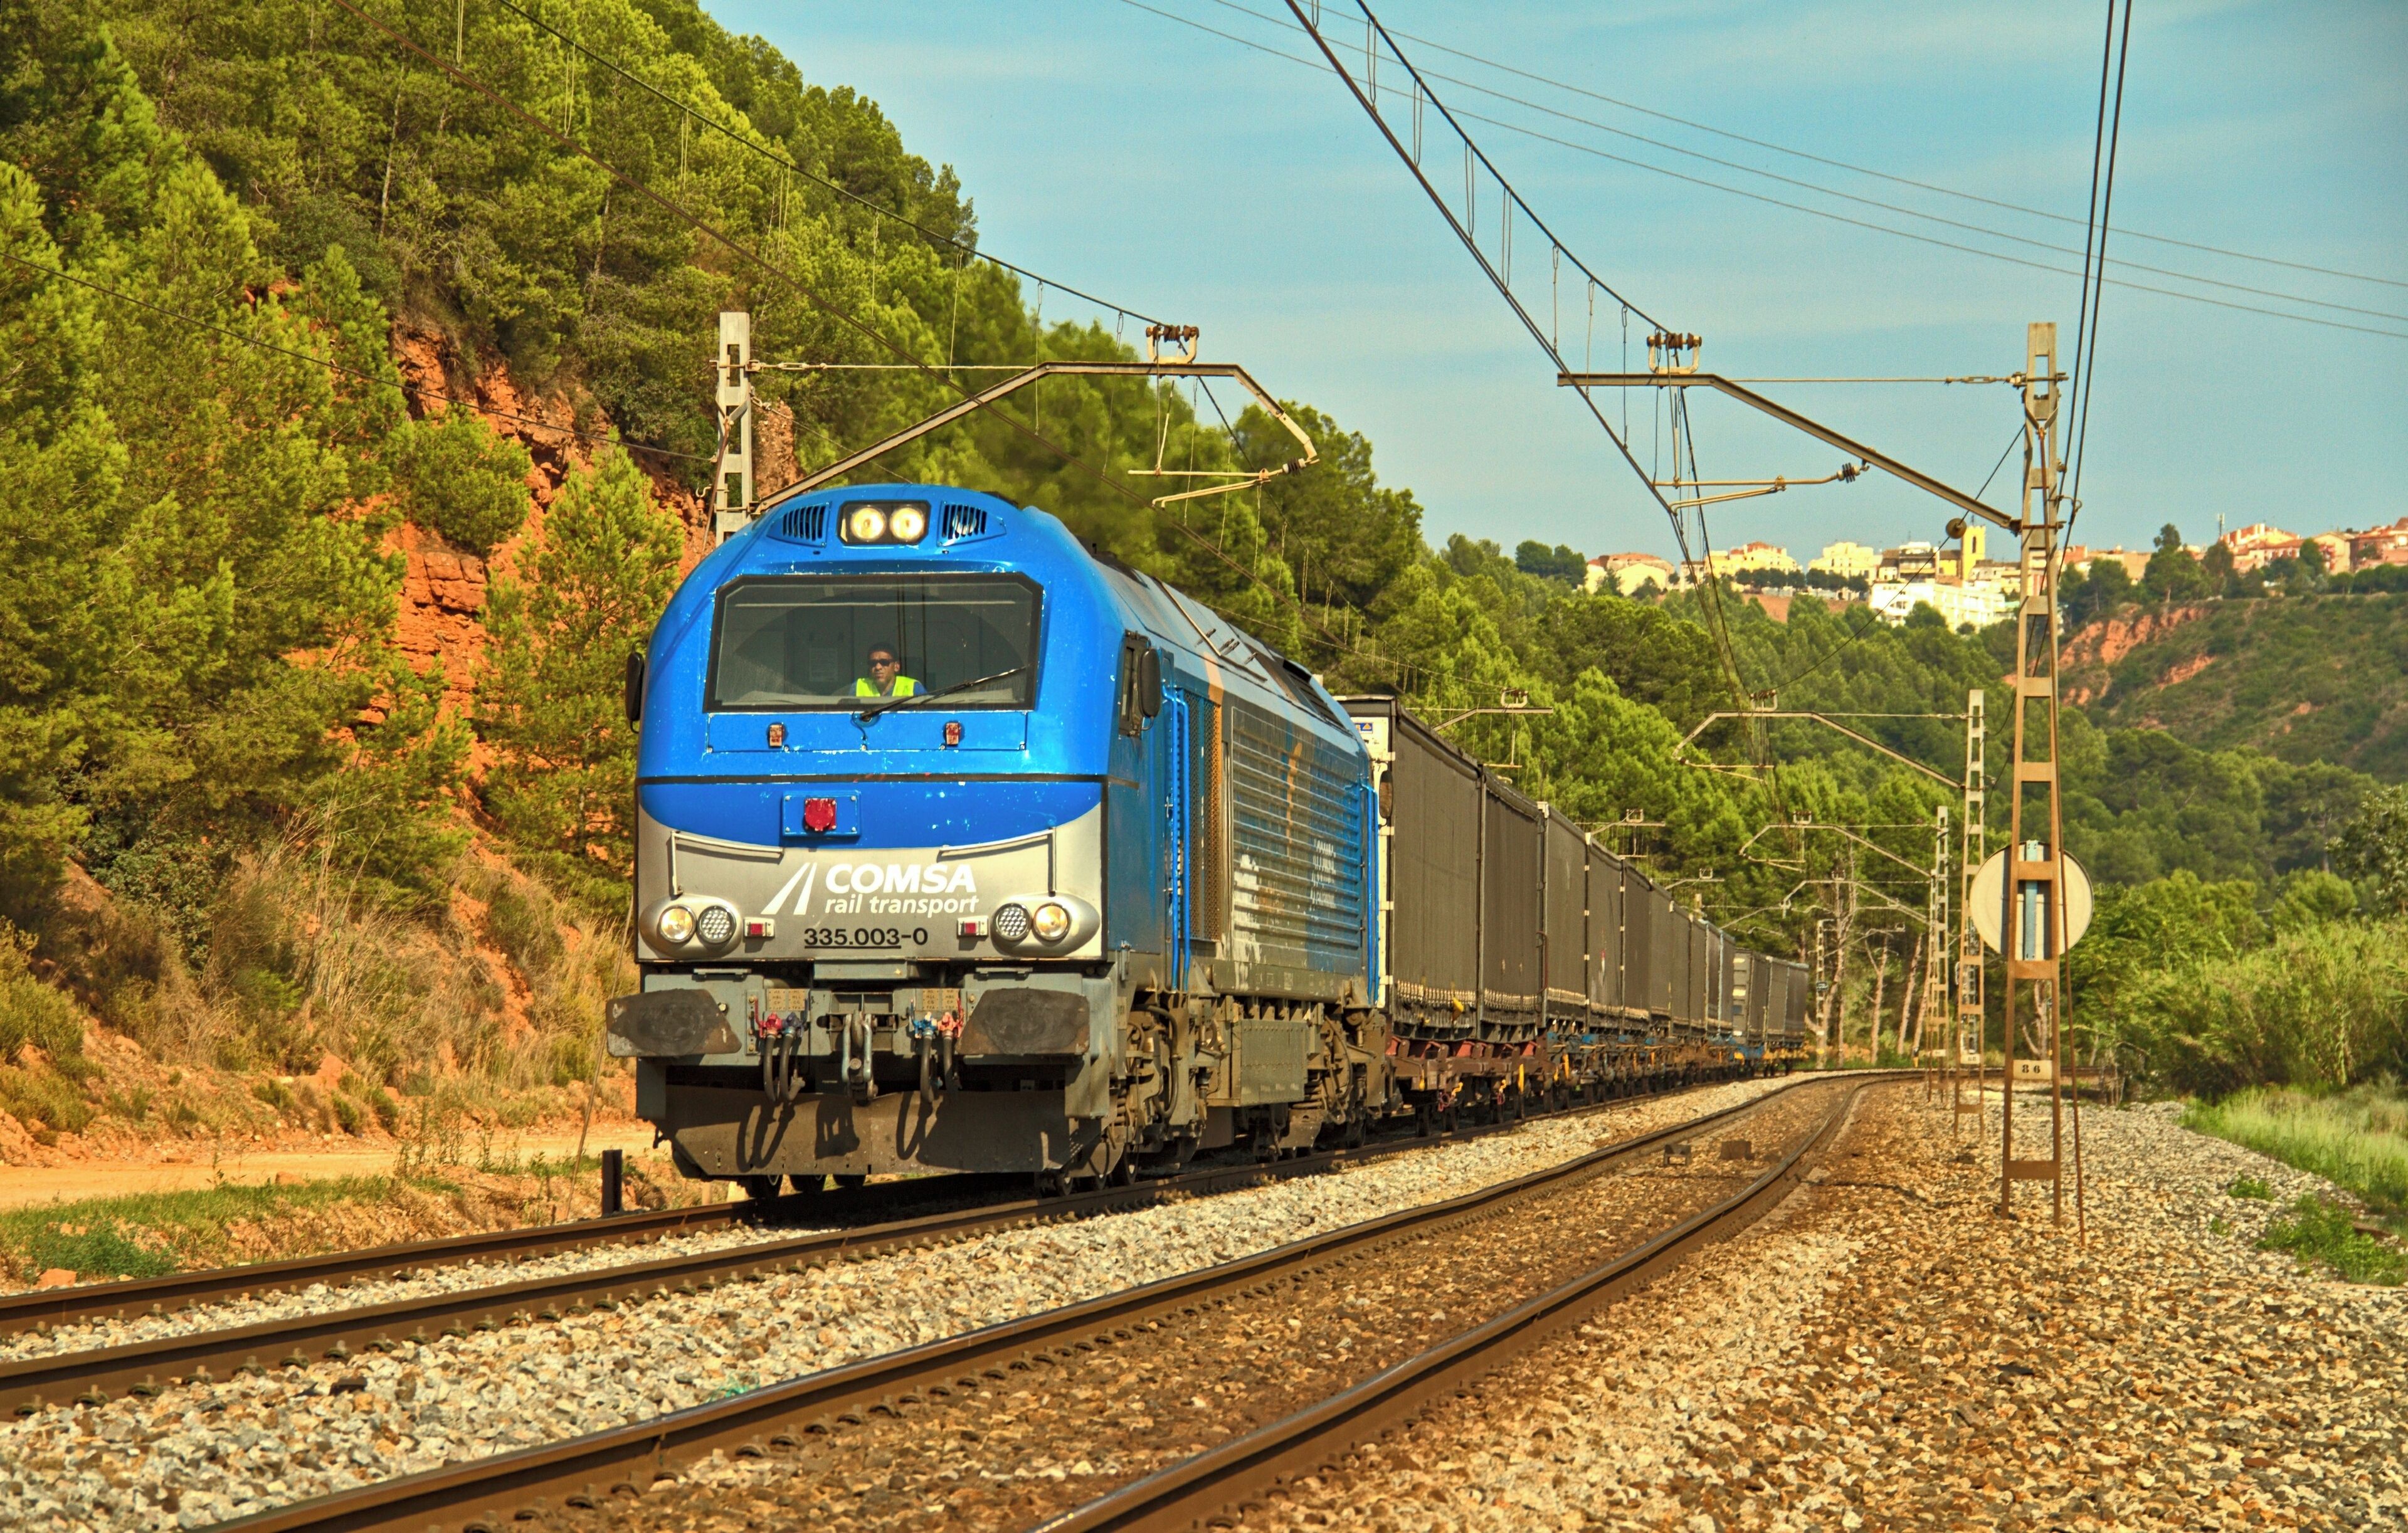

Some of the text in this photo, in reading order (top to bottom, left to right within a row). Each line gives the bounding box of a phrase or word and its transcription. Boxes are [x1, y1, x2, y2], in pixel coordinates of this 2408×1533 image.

[825, 863, 976, 893] COMSA
[825, 893, 980, 918] rail transport
[804, 927, 928, 946] 335.003-0
[2022, 1065, 2041, 1073] 86
